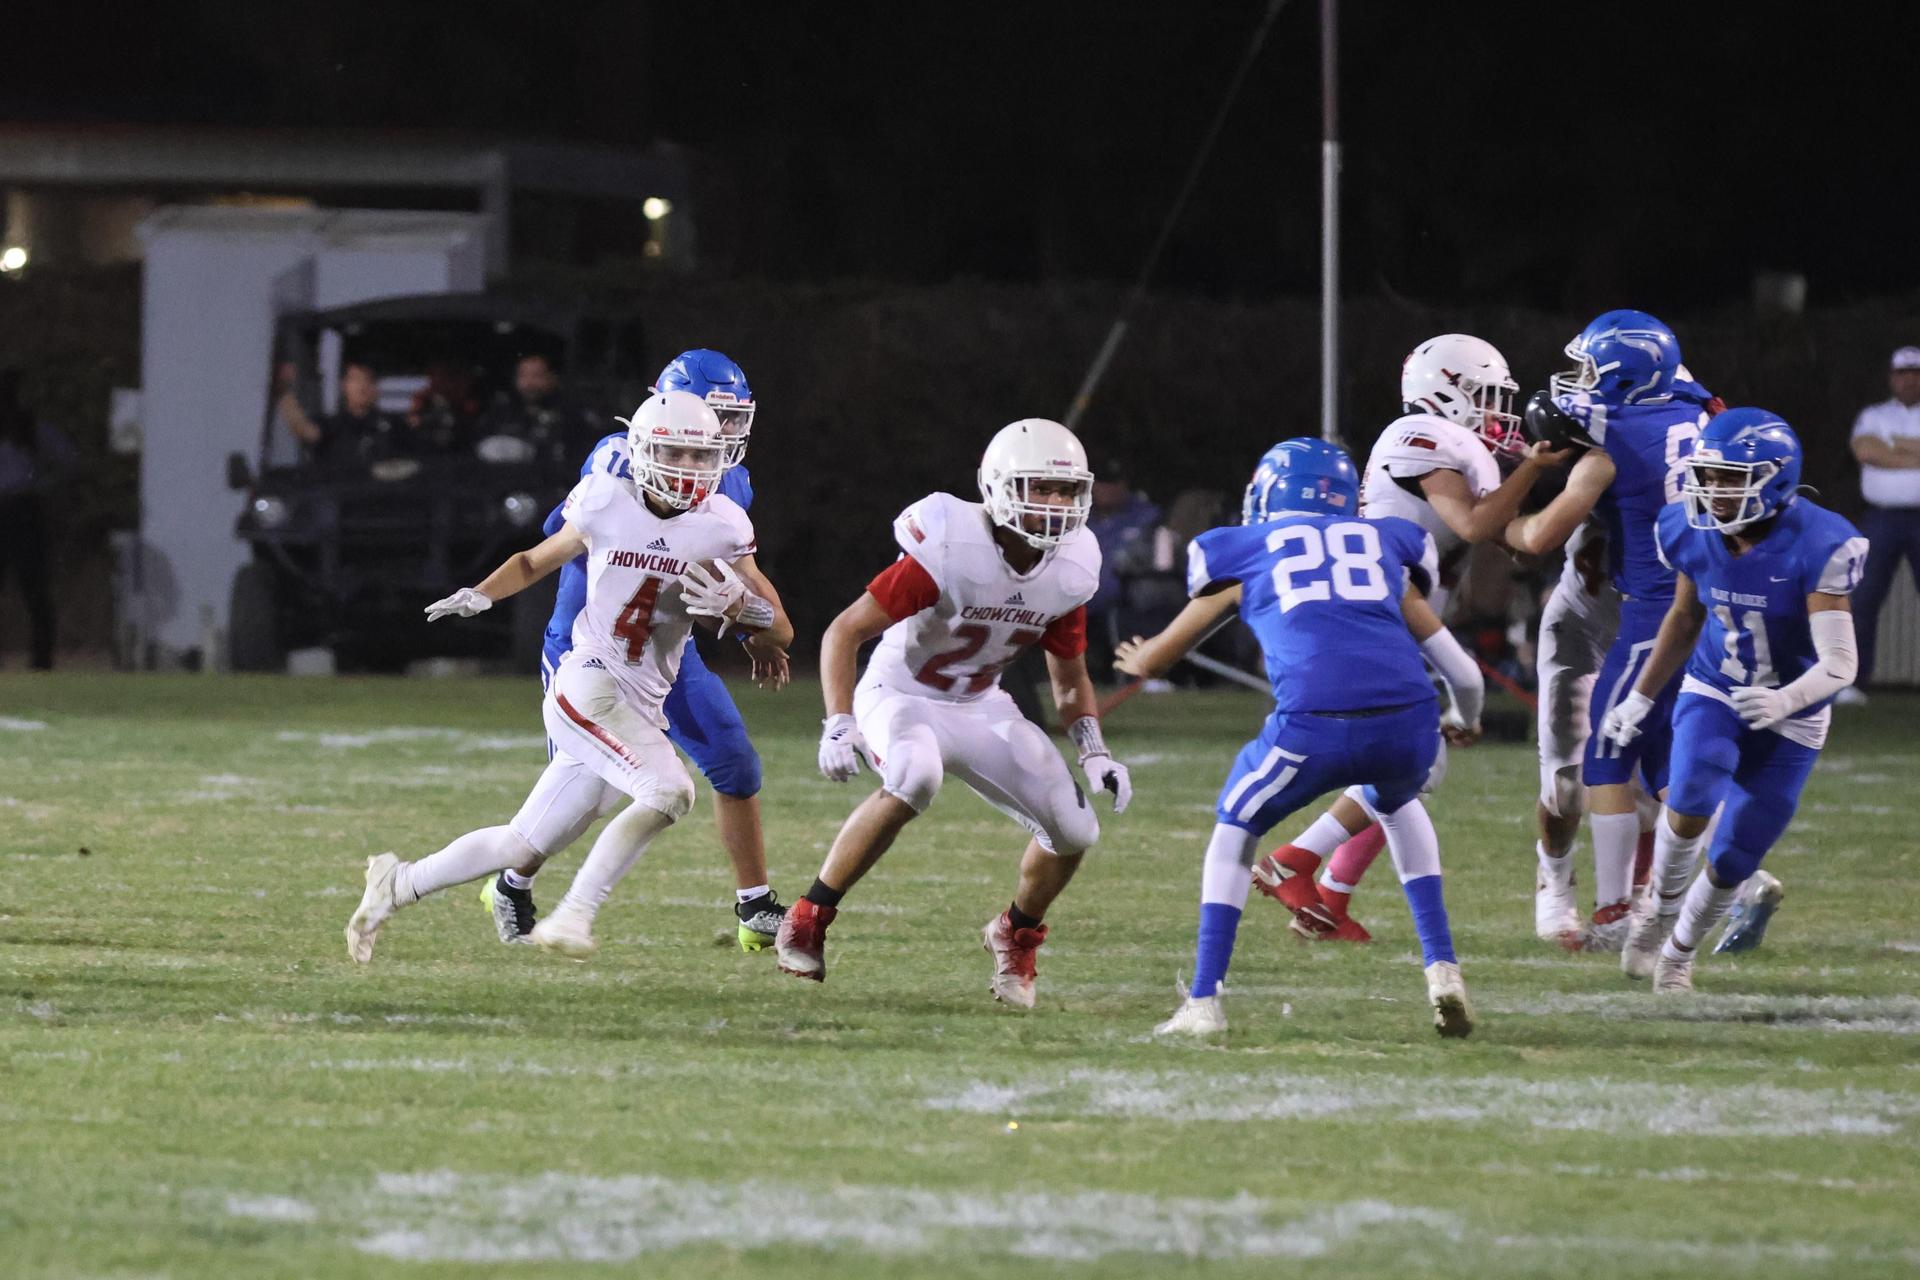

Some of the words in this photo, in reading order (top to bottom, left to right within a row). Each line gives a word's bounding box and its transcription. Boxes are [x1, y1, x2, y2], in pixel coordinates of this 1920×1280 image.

[606, 549, 688, 576] CHOWCHILL
[646, 543, 670, 552] adidas
[1266, 522, 1390, 614] 28
[609, 573, 664, 667] 4
[1712, 604, 1780, 688] 11
